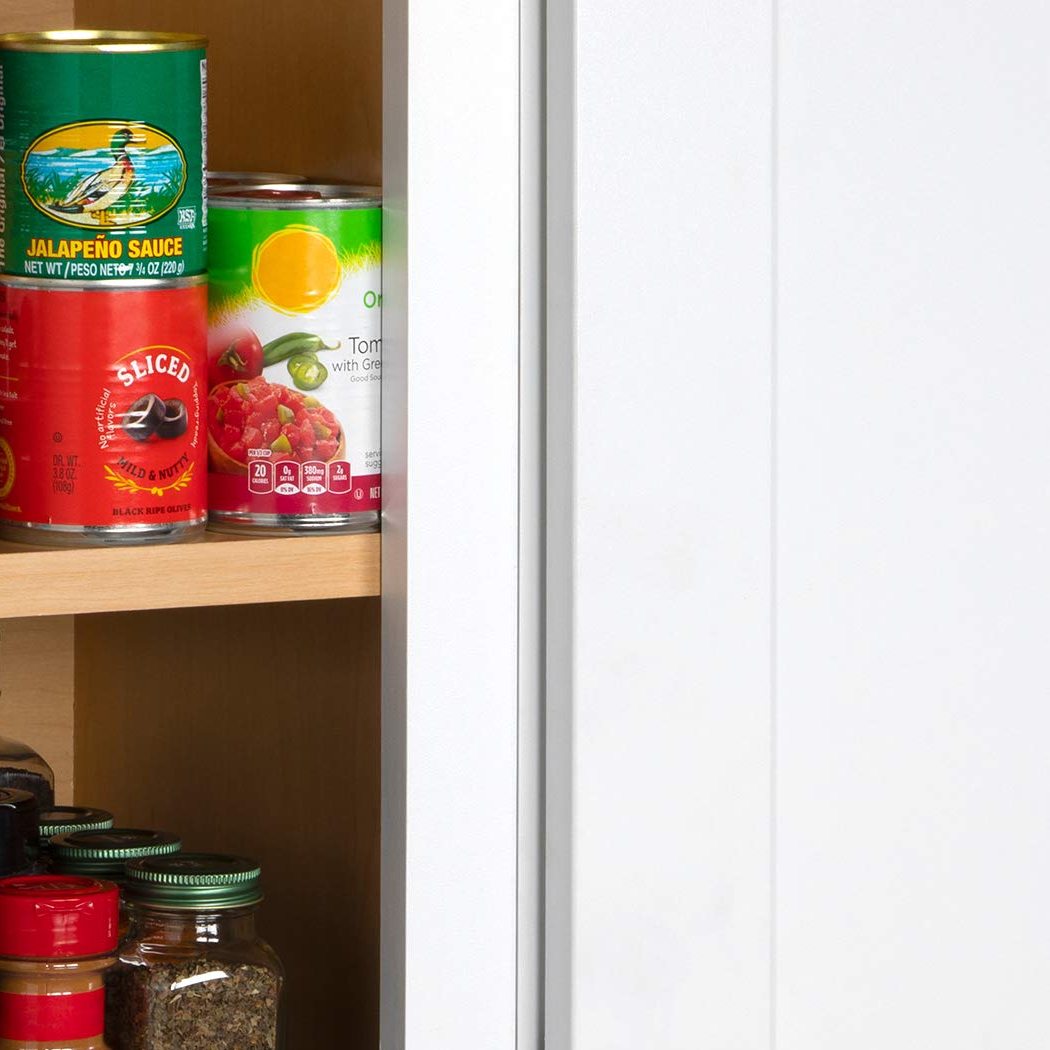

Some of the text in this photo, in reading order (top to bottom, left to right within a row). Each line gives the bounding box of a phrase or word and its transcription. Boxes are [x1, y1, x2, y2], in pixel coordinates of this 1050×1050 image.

[26, 234, 183, 259] JALAPEÑO SAUCE
[24, 260, 42, 274] NET
[147, 262, 159, 275] OZ
[117, 353, 191, 387] SLICED
[332, 360, 358, 372] with
[350, 375, 369, 383] Good
[96, 388, 112, 450] No artificial
[106, 402, 118, 441] flavors
[116, 452, 190, 481] MILD & NUTTY
[254, 464, 266, 477] 20
[112, 503, 191, 516] BLACK RIPE OLIVES
